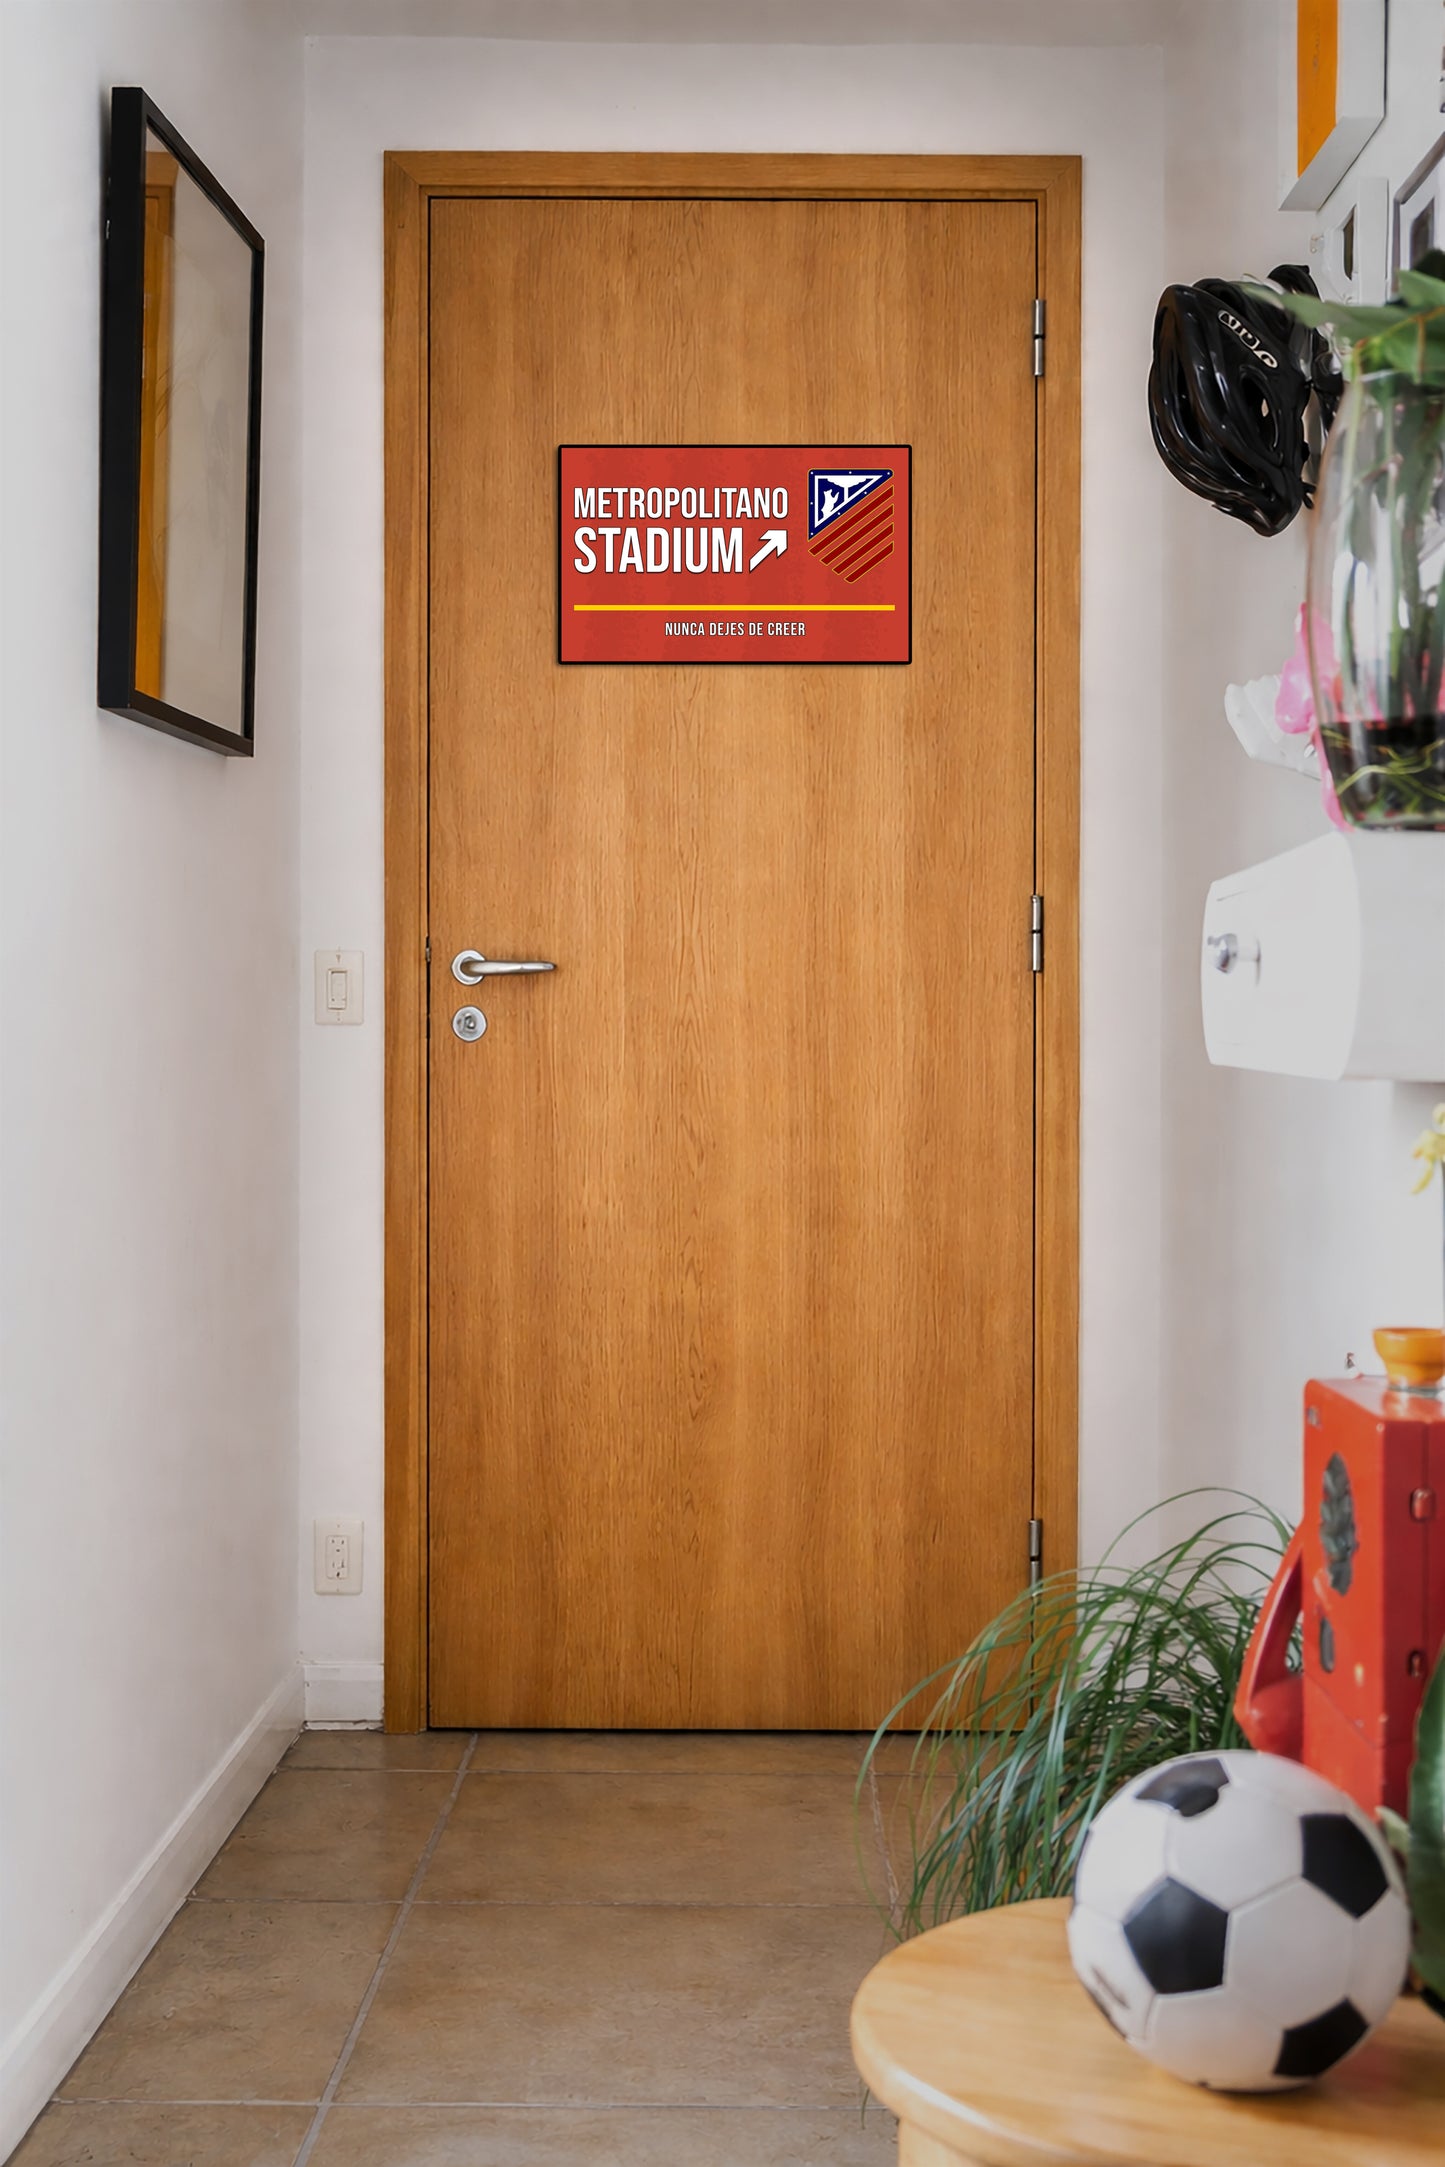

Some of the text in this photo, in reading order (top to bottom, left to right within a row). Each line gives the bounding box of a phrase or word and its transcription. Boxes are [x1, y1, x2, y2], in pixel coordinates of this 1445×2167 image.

[574, 487, 788, 519] METROPOLITANO
[574, 527, 743, 573] STADIUM
[665, 622, 806, 636] NUNCA DEJES DE CREER
